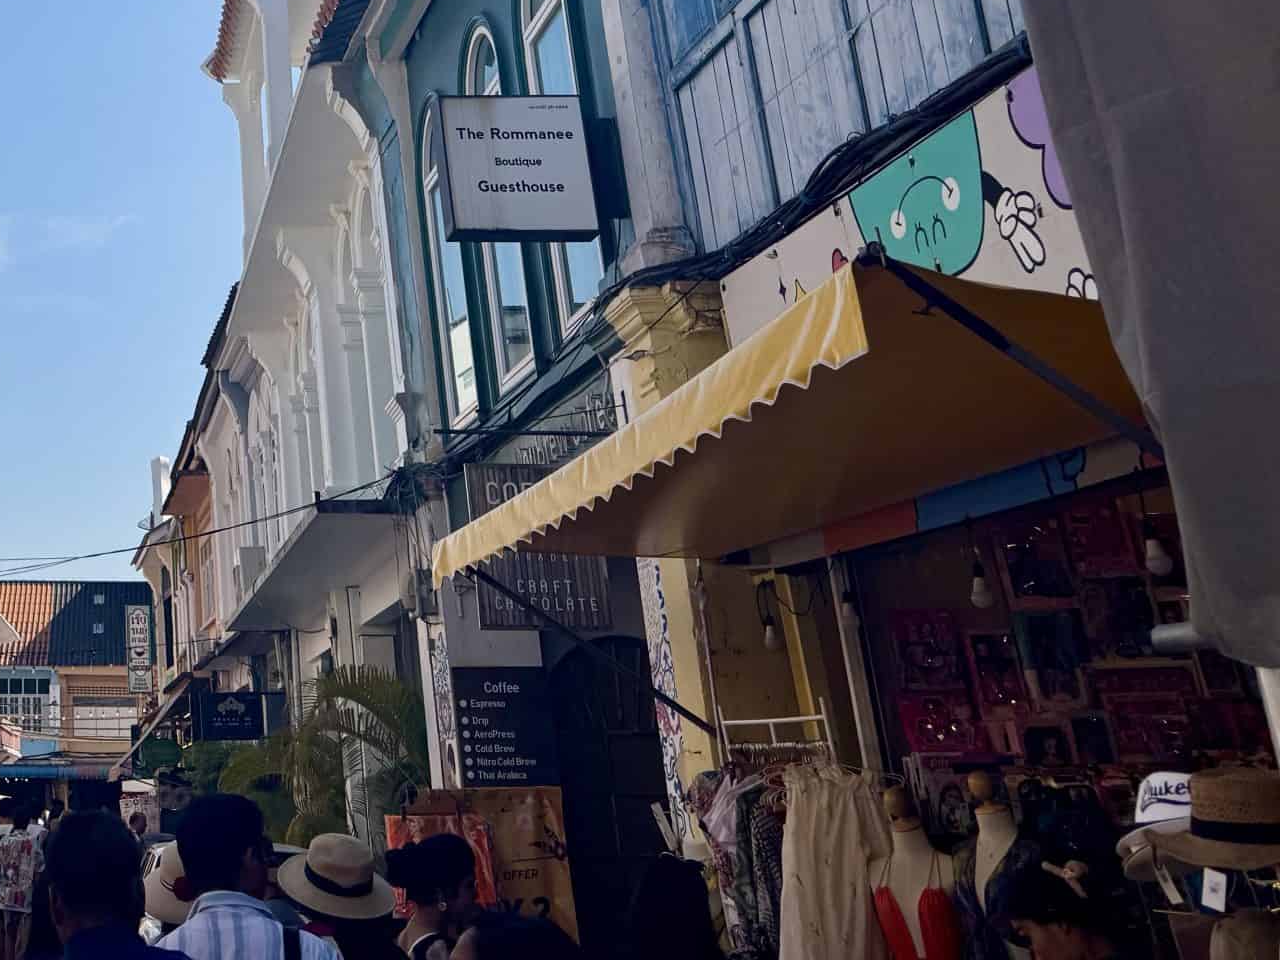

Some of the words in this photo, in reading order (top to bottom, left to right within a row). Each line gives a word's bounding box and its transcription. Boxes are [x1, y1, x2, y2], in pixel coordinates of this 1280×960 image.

[456, 127, 484, 140] The
[490, 127, 573, 140] Rommanee
[495, 156, 543, 168] Boutique
[478, 180, 565, 193] Guesthouse
[517, 578, 571, 594] CRAFT
[483, 681, 520, 694] Coffee
[470, 699, 506, 709] Espresso
[475, 744, 493, 753] Cold
[494, 744, 516, 753] Brew
[503, 868, 539, 881] OFFER
